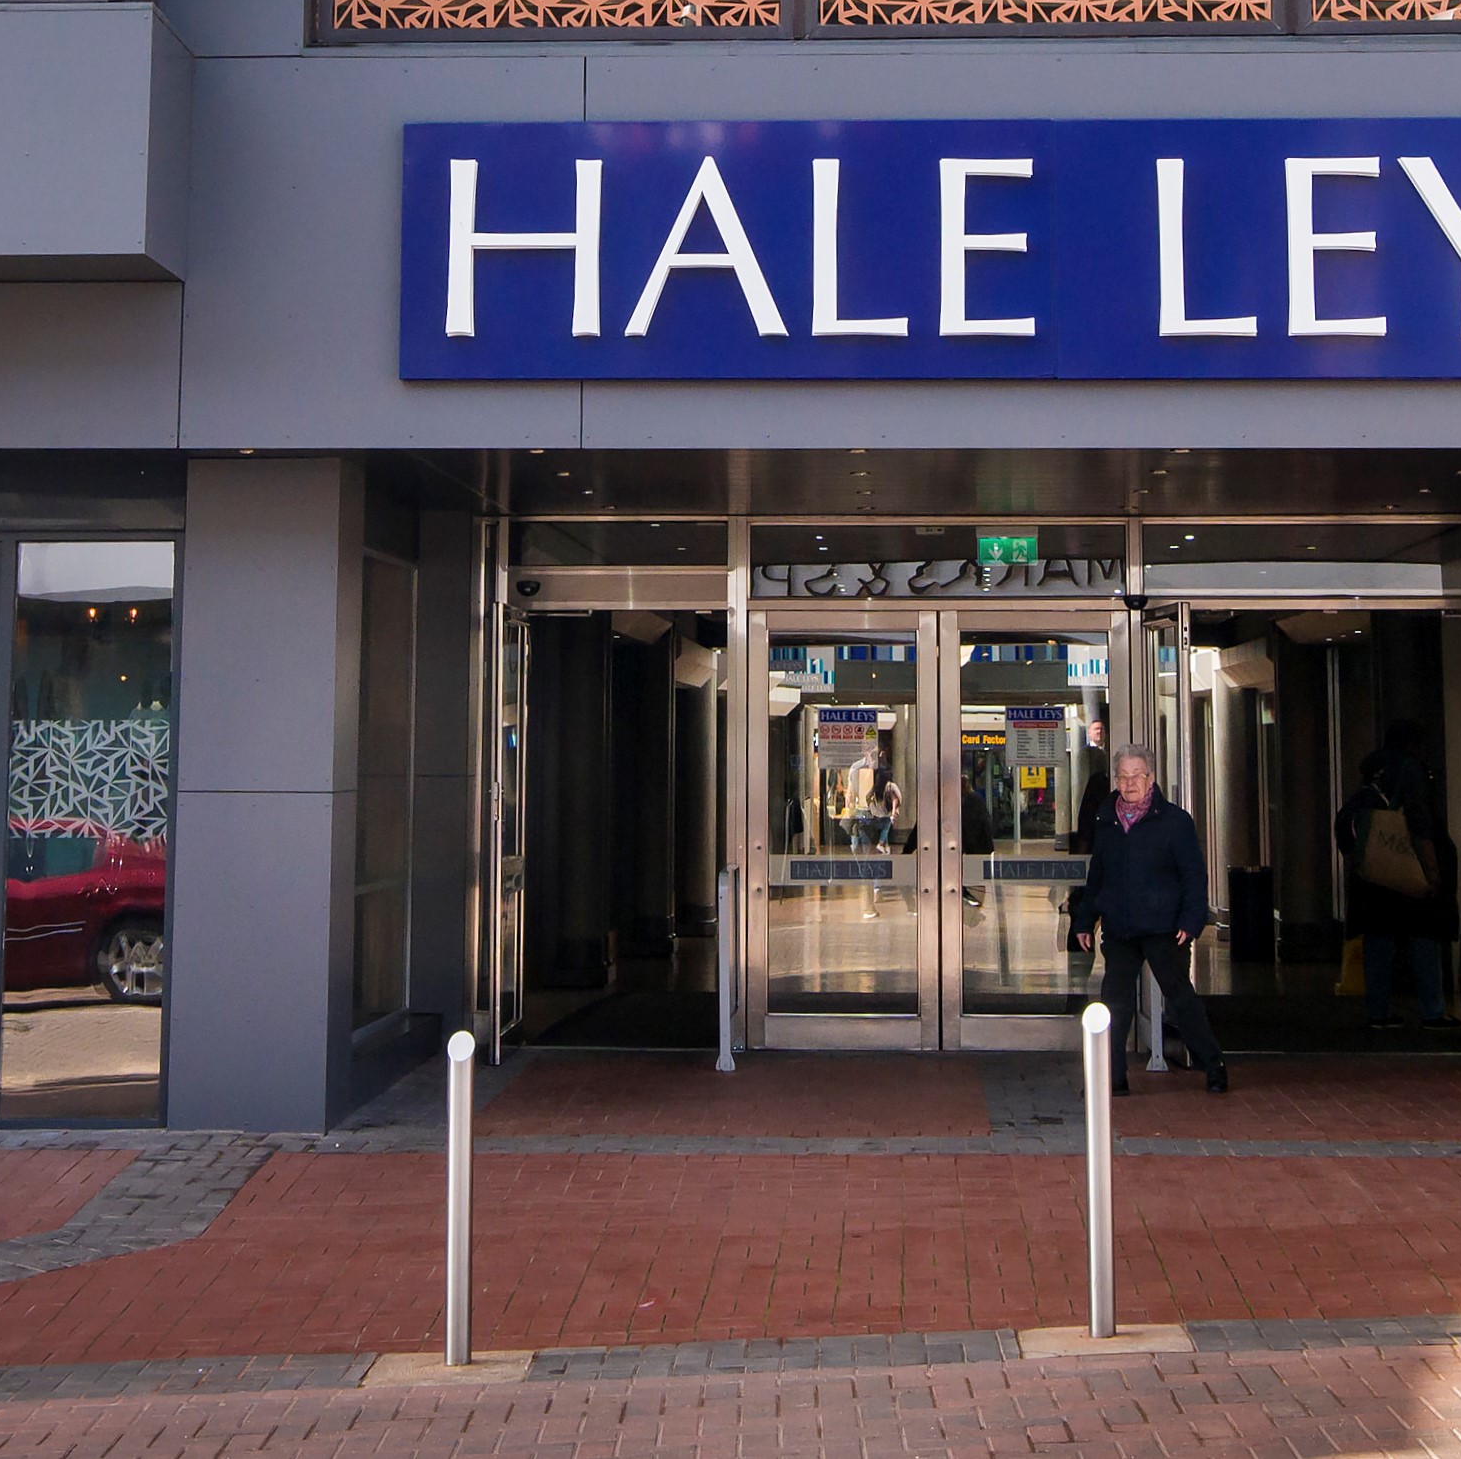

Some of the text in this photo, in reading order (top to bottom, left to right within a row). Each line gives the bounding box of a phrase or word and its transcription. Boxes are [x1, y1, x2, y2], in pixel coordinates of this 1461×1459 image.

[444, 154, 1036, 339] HALE
[821, 711, 875, 721] HALE LEYS
[1008, 709, 1063, 719] HALE LEYS
[961, 734, 981, 745] Card
